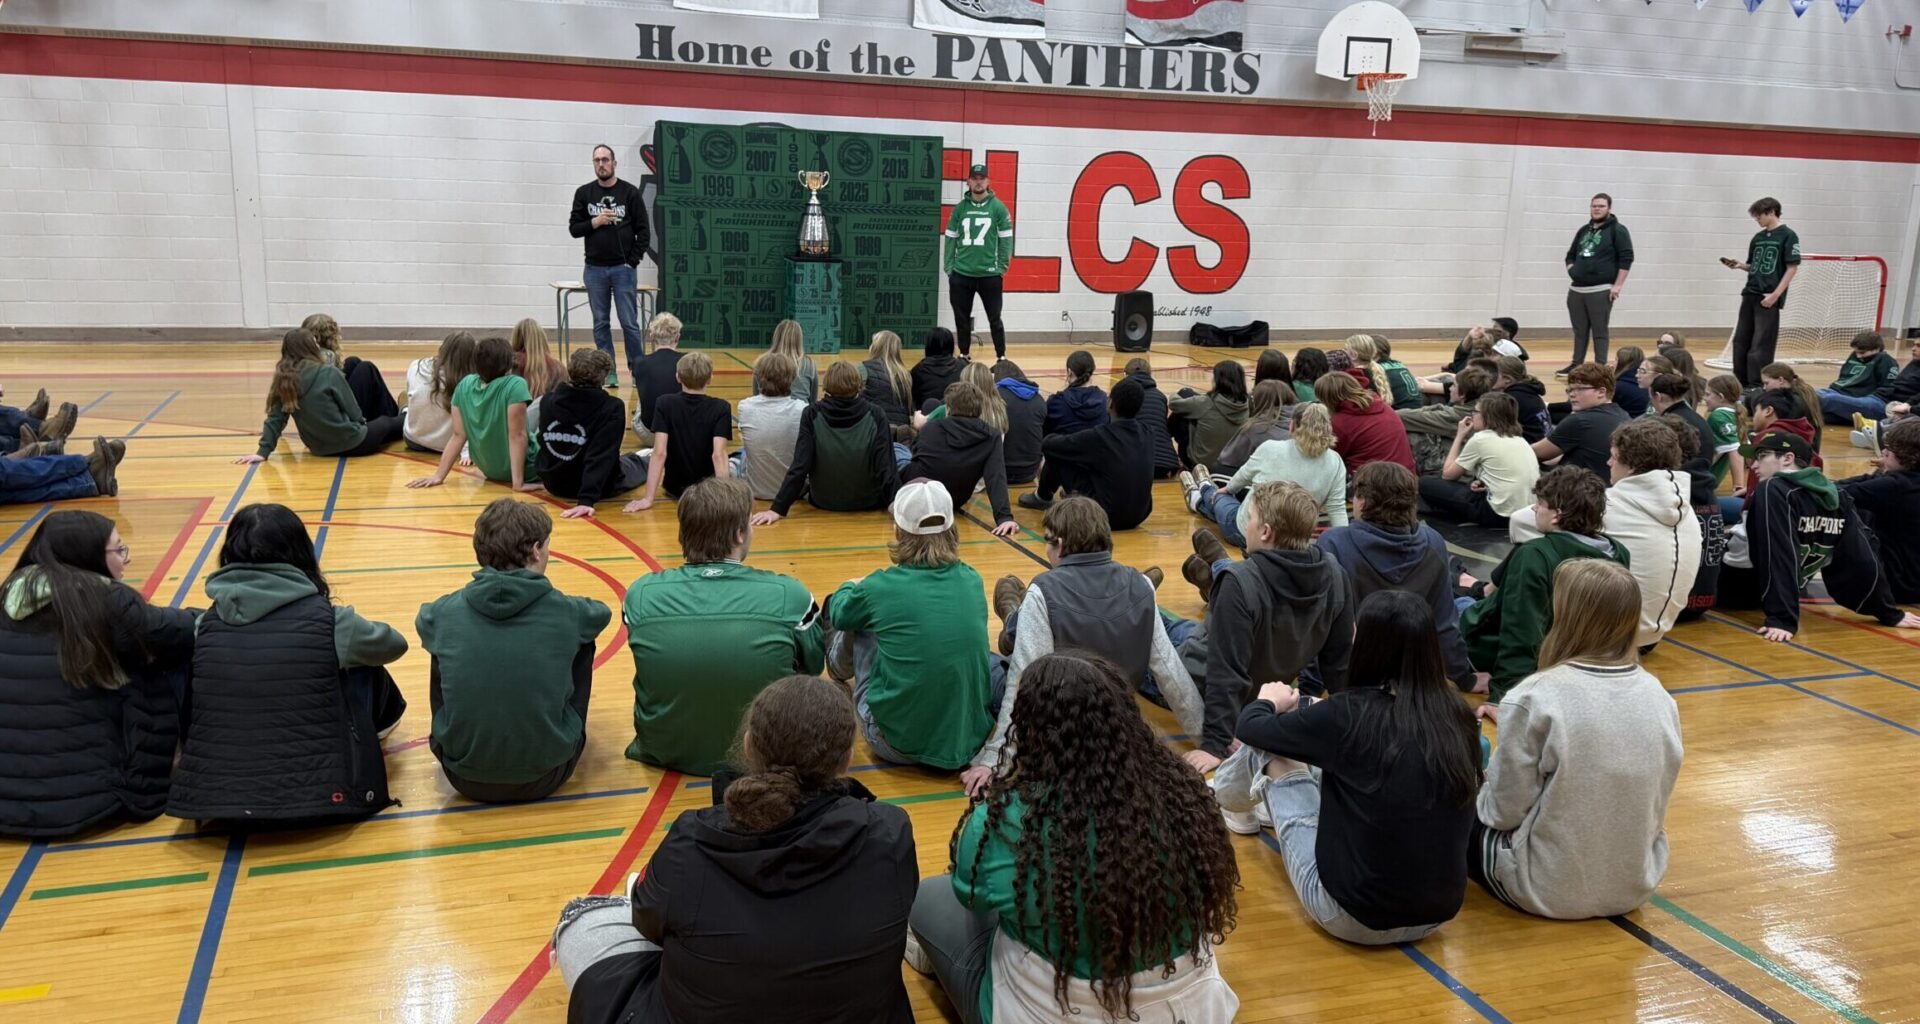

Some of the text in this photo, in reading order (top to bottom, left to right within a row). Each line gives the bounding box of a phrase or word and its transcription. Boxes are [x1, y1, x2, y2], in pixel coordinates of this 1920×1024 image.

[635, 23, 1261, 95] Home of the PANTHERS
[745, 150, 778, 172] 2007
[881, 156, 909, 179] 2013
[703, 174, 734, 198] 1989
[839, 181, 869, 203] 2025
[941, 147, 1251, 294] LCS
[962, 217, 992, 246] 17
[742, 289, 776, 312] 2025
[874, 292, 904, 314] 2013
[1189, 306, 1213, 317] 1948
